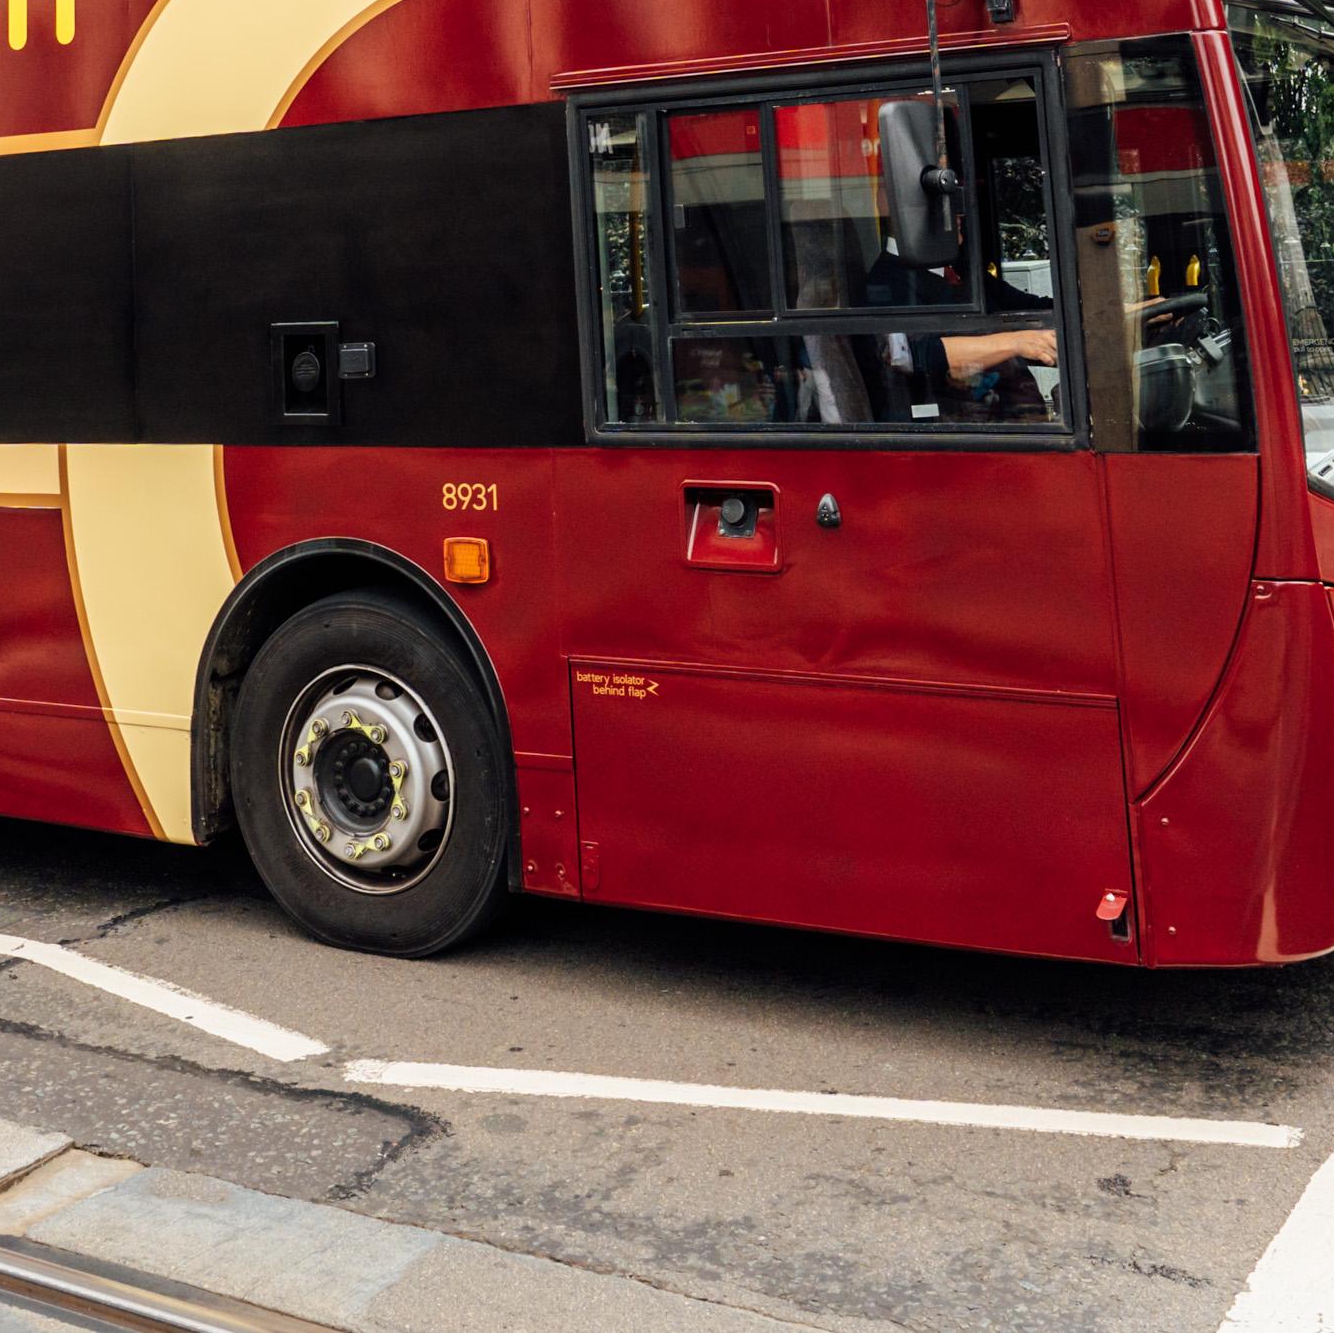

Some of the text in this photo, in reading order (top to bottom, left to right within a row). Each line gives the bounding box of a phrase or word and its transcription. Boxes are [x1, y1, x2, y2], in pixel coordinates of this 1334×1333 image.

[442, 482, 498, 511] 8931
[576, 671, 645, 685] battery isolator
[592, 684, 646, 700] behind flap
